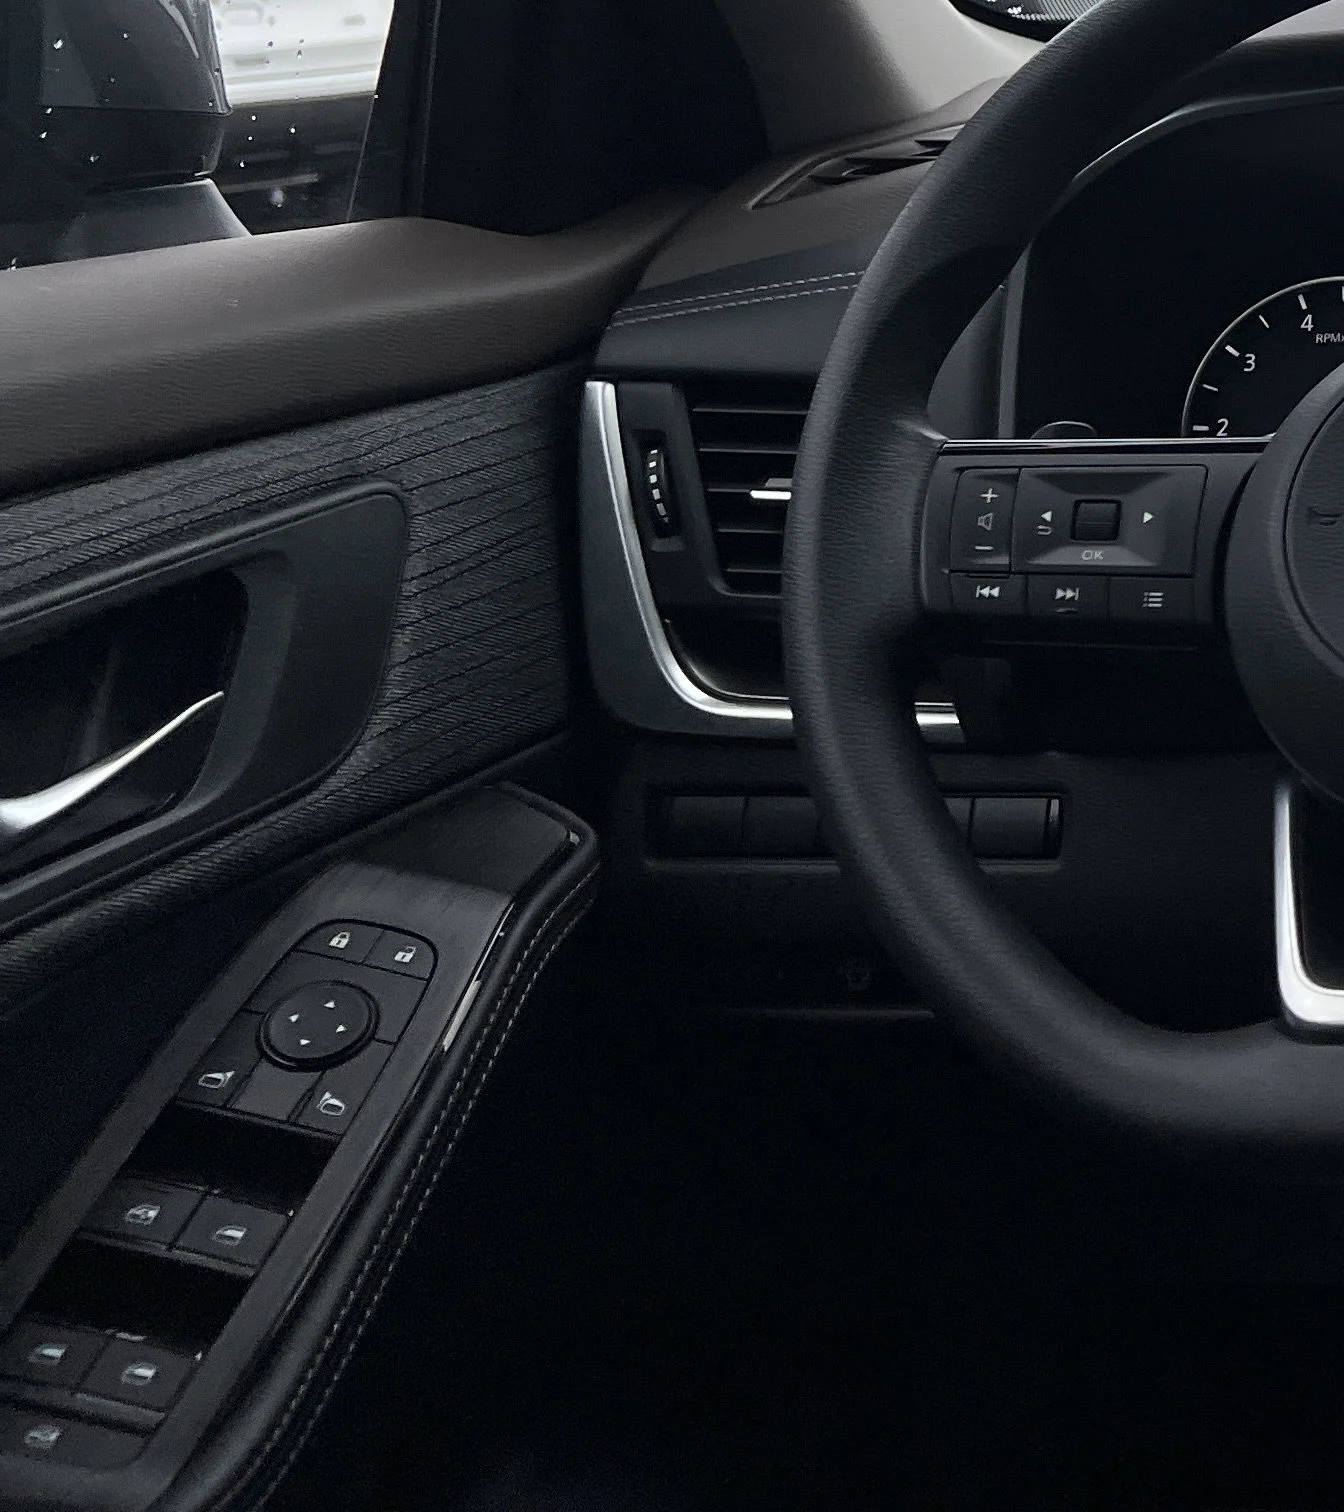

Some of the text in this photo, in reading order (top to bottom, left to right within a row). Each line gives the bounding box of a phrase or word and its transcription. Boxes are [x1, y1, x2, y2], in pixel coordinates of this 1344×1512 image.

[1300, 313, 1315, 333] 4
[1243, 353, 1257, 373] 3
[1214, 417, 1230, 437] 2
[1081, 549, 1105, 561] OK
